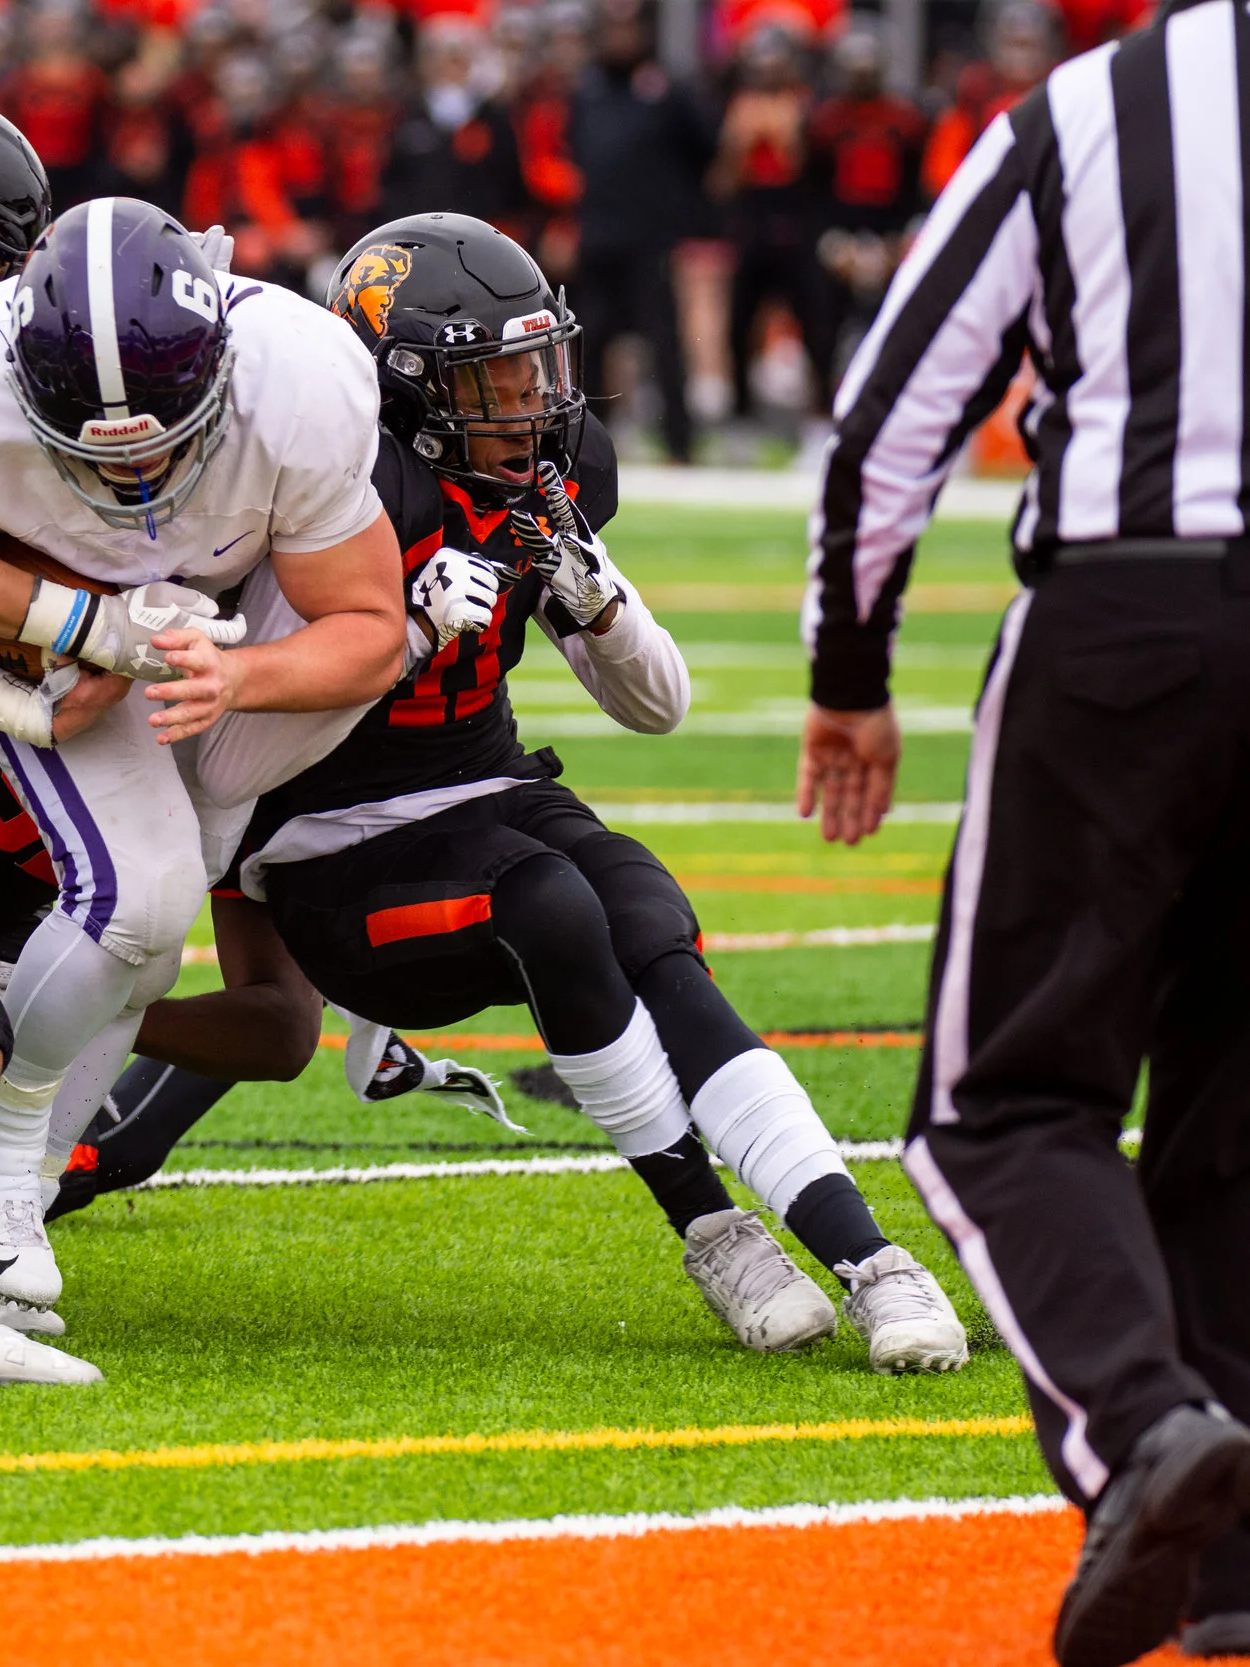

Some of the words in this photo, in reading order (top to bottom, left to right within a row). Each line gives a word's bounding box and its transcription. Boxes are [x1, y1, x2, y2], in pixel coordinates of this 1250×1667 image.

[172, 269, 219, 324] 6
[521, 314, 551, 333] VILLE
[90, 420, 149, 436] Riddell
